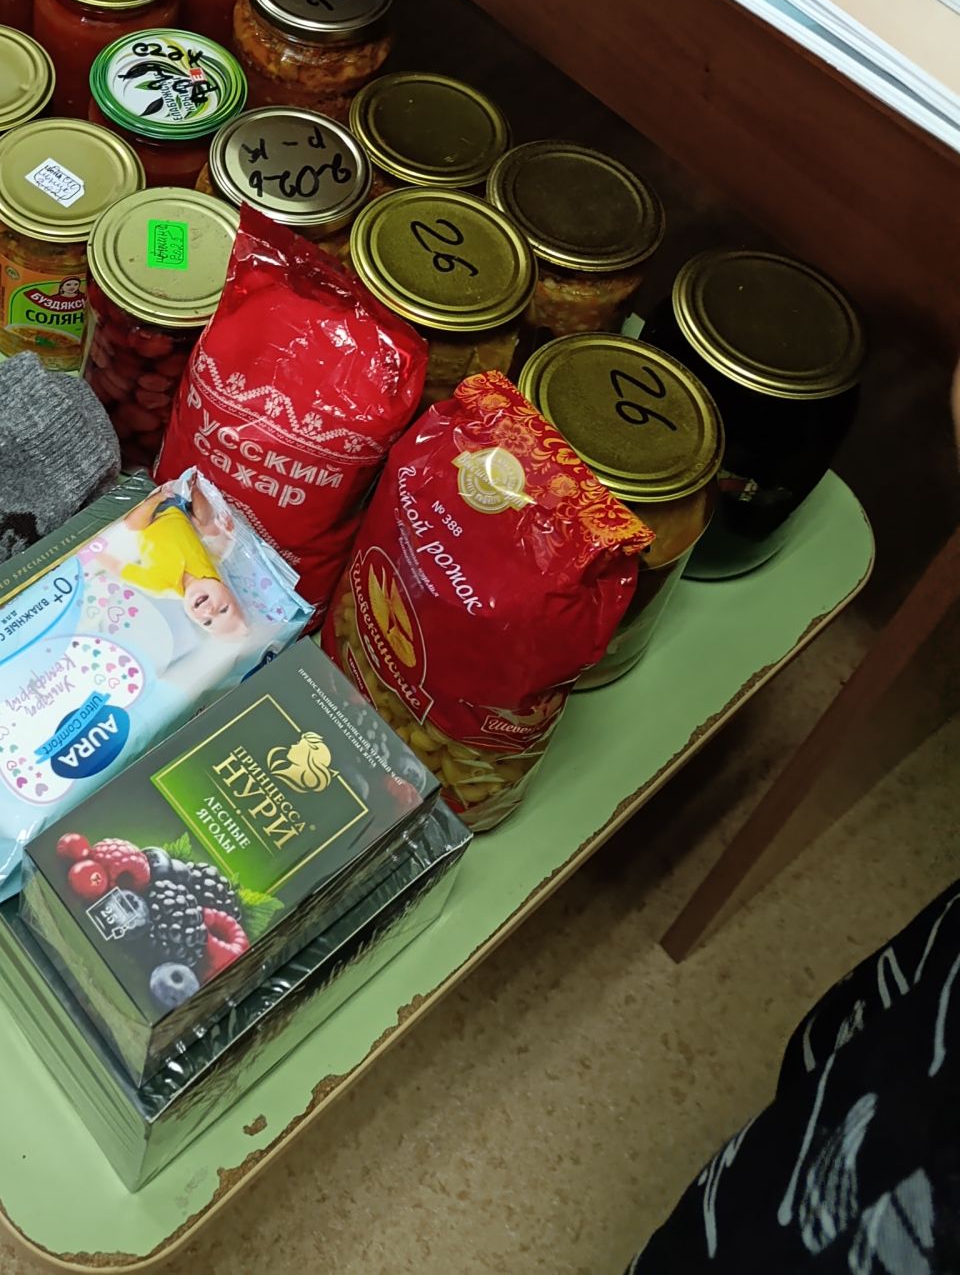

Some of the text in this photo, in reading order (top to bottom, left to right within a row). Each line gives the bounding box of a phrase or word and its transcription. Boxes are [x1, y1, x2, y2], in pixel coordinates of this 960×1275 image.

[60, 534, 78, 546] TEA
[397, 465, 434, 538] Витой
[417, 538, 485, 616] рожок
[431, 500, 464, 538] № 388
[52, 577, 73, 604] 0+
[7, 598, 50, 636] ВЛАЖНЫЕ
[42, 695, 103, 755] Ultra Comfort
[57, 713, 119, 768] AURA
[211, 752, 300, 850] НУРИ
[233, 745, 306, 834] ПРИНЦЕССА
[196, 807, 237, 854] ЯГОДЫ
[202, 795, 251, 849] ЛЕСНЫЕ
[100, 906, 118, 925] 25
